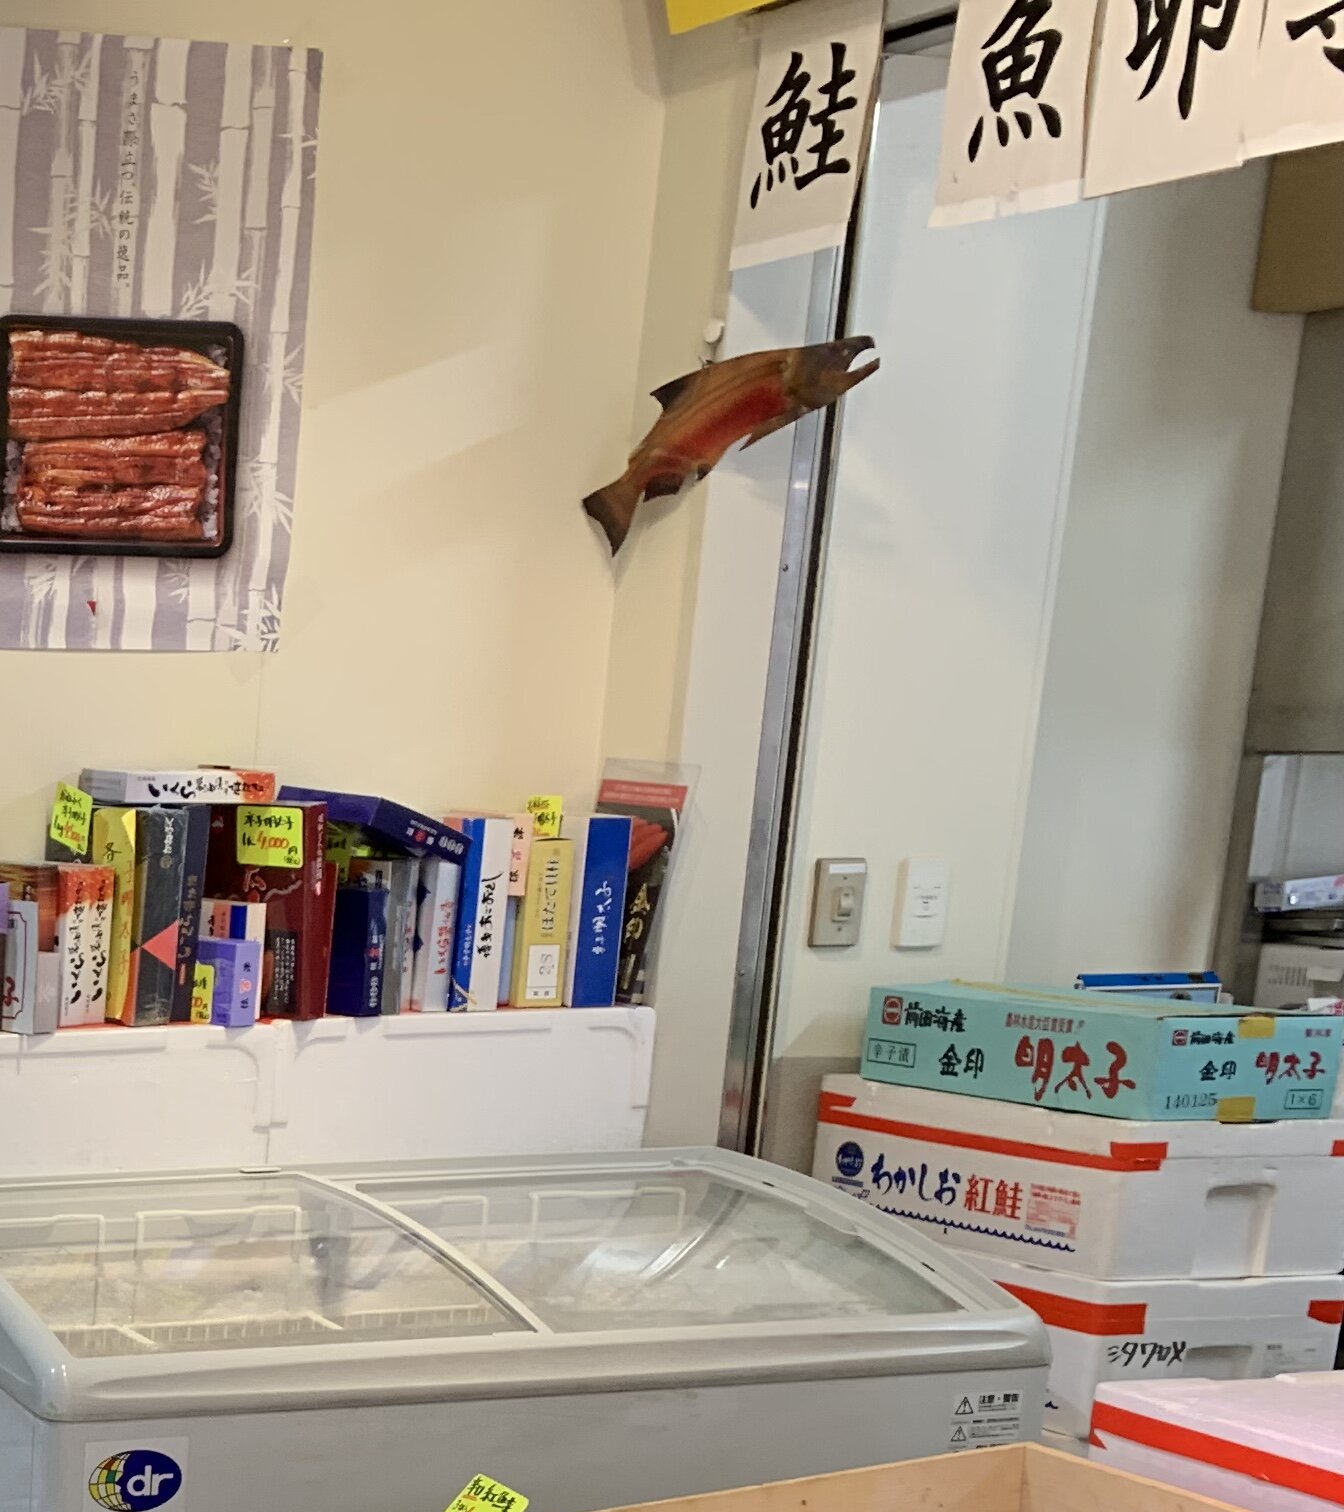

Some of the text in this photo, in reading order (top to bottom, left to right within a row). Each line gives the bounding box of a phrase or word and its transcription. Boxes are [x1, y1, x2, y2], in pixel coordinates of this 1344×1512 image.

[968, 0, 1063, 162] 魚
[749, 41, 858, 209] 鮭
[938, 1044, 984, 1079] 金印
[1015, 1035, 1136, 1101] 明太子
[1255, 1051, 1325, 1085] 明太子
